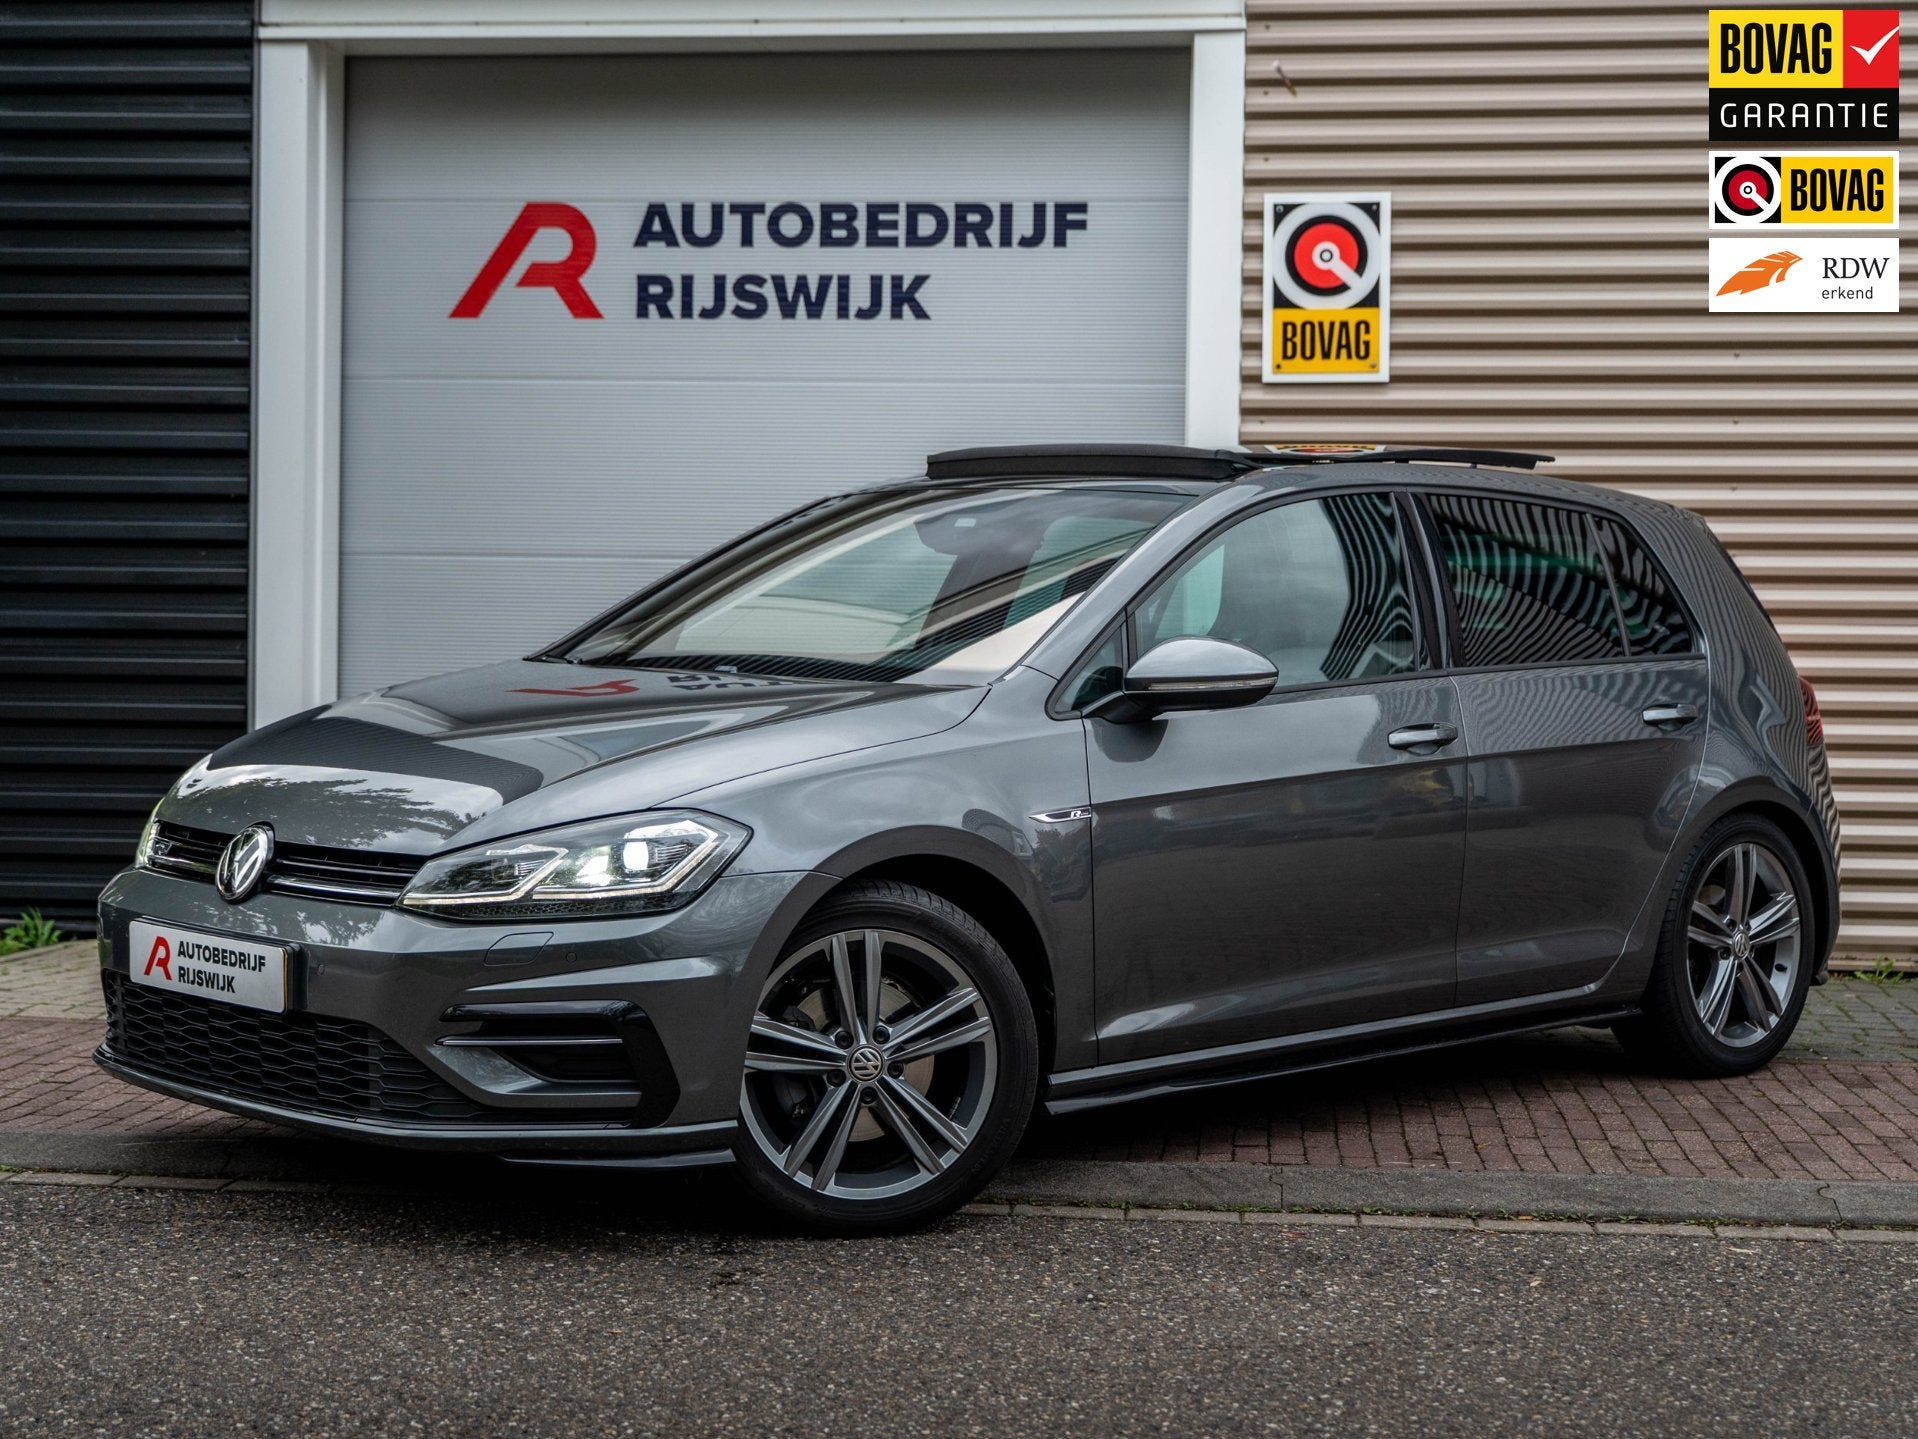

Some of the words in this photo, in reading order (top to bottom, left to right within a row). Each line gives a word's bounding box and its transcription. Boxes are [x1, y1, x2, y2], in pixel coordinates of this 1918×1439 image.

[633, 201, 1088, 249] AUTOBEDRIJF
[635, 273, 931, 320] RIJSWIJK
[1281, 319, 1371, 361] BOVAG
[177, 940, 266, 973] AUTOBEDRIJF
[178, 966, 235, 993] RIJSWIJK
